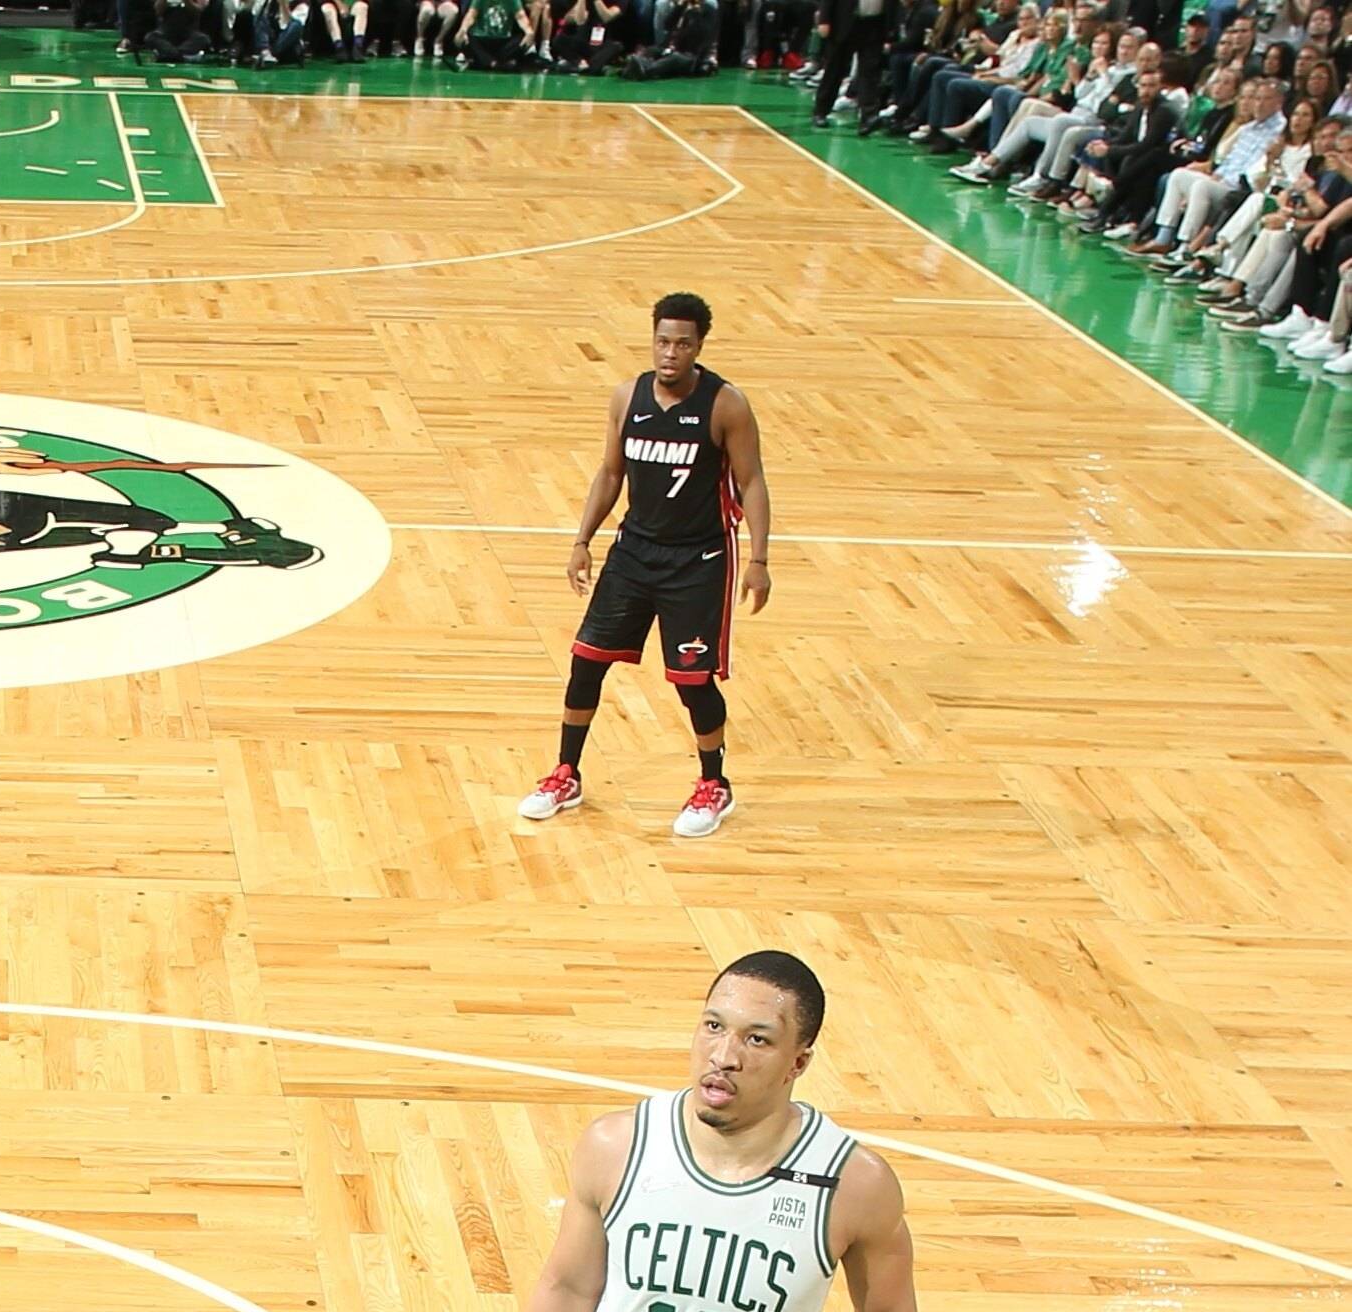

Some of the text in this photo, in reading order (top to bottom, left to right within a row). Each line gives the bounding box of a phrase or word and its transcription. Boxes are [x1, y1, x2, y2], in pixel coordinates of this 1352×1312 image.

[678, 415, 700, 425] UKG
[624, 437, 700, 465] MIAMI
[665, 468, 692, 498] 7
[793, 1172, 809, 1184] 24
[772, 1196, 807, 1216] VISTA
[768, 1213, 805, 1230] PRINT
